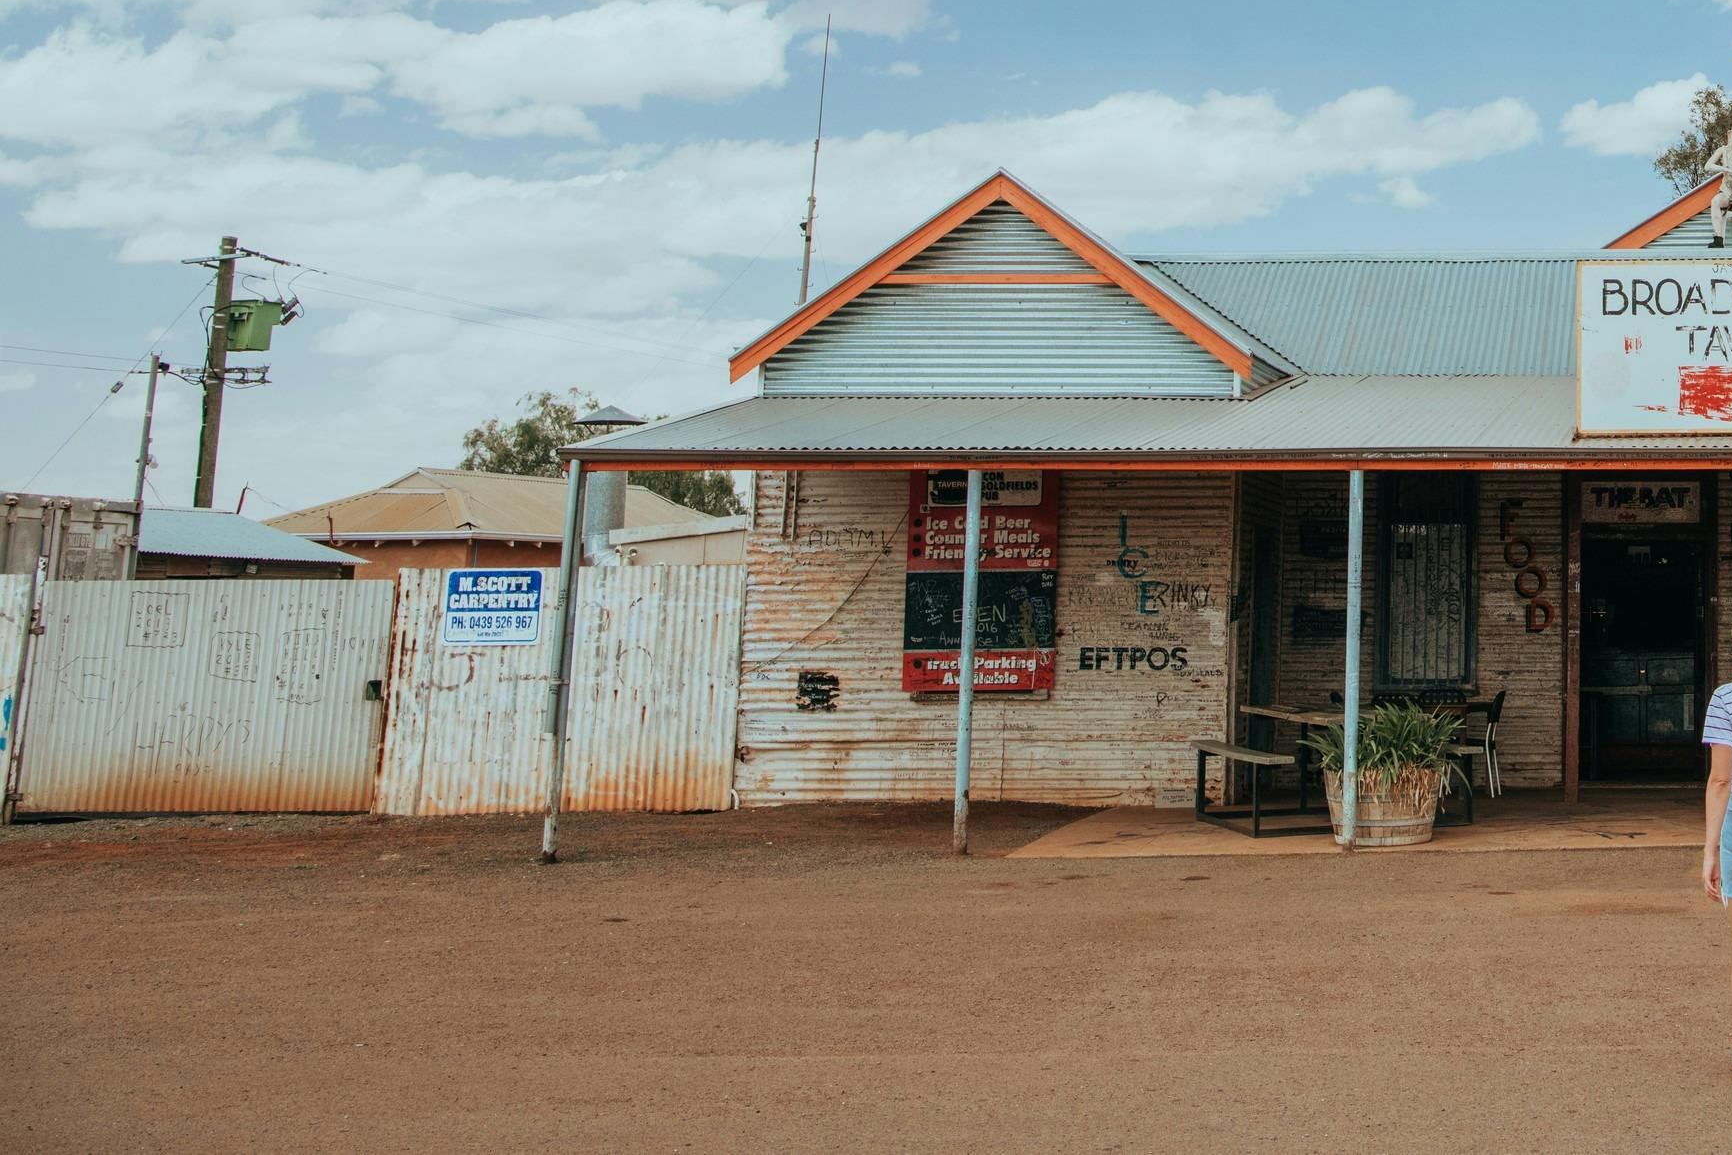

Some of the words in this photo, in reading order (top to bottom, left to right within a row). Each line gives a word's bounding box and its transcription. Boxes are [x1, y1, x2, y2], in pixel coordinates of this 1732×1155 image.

[937, 480, 968, 488] TAVERN
[980, 472, 1004, 480] CON
[1590, 486, 1636, 508] THE
[925, 516, 948, 531] Ice
[954, 515, 989, 530] Cd
[995, 515, 1032, 530] Beer
[924, 530, 988, 545] Counr
[993, 529, 1041, 545] Meals
[924, 545, 988, 562] Frieny
[994, 545, 1052, 560] Service
[1499, 500, 1555, 634] FOOD
[458, 576, 531, 592] M.SCOTT
[449, 592, 538, 609] CARPENTRY
[952, 603, 1006, 623] EEN
[451, 616, 466, 629] PH:
[469, 615, 493, 629] 0439
[495, 615, 513, 629] 526
[515, 615, 533, 629] 967
[974, 622, 999, 634] 016
[926, 657, 961, 670] Truc
[973, 656, 1037, 672] Parking
[1079, 646, 1188, 671] EFTPOS
[942, 672, 1019, 686] Avilable
